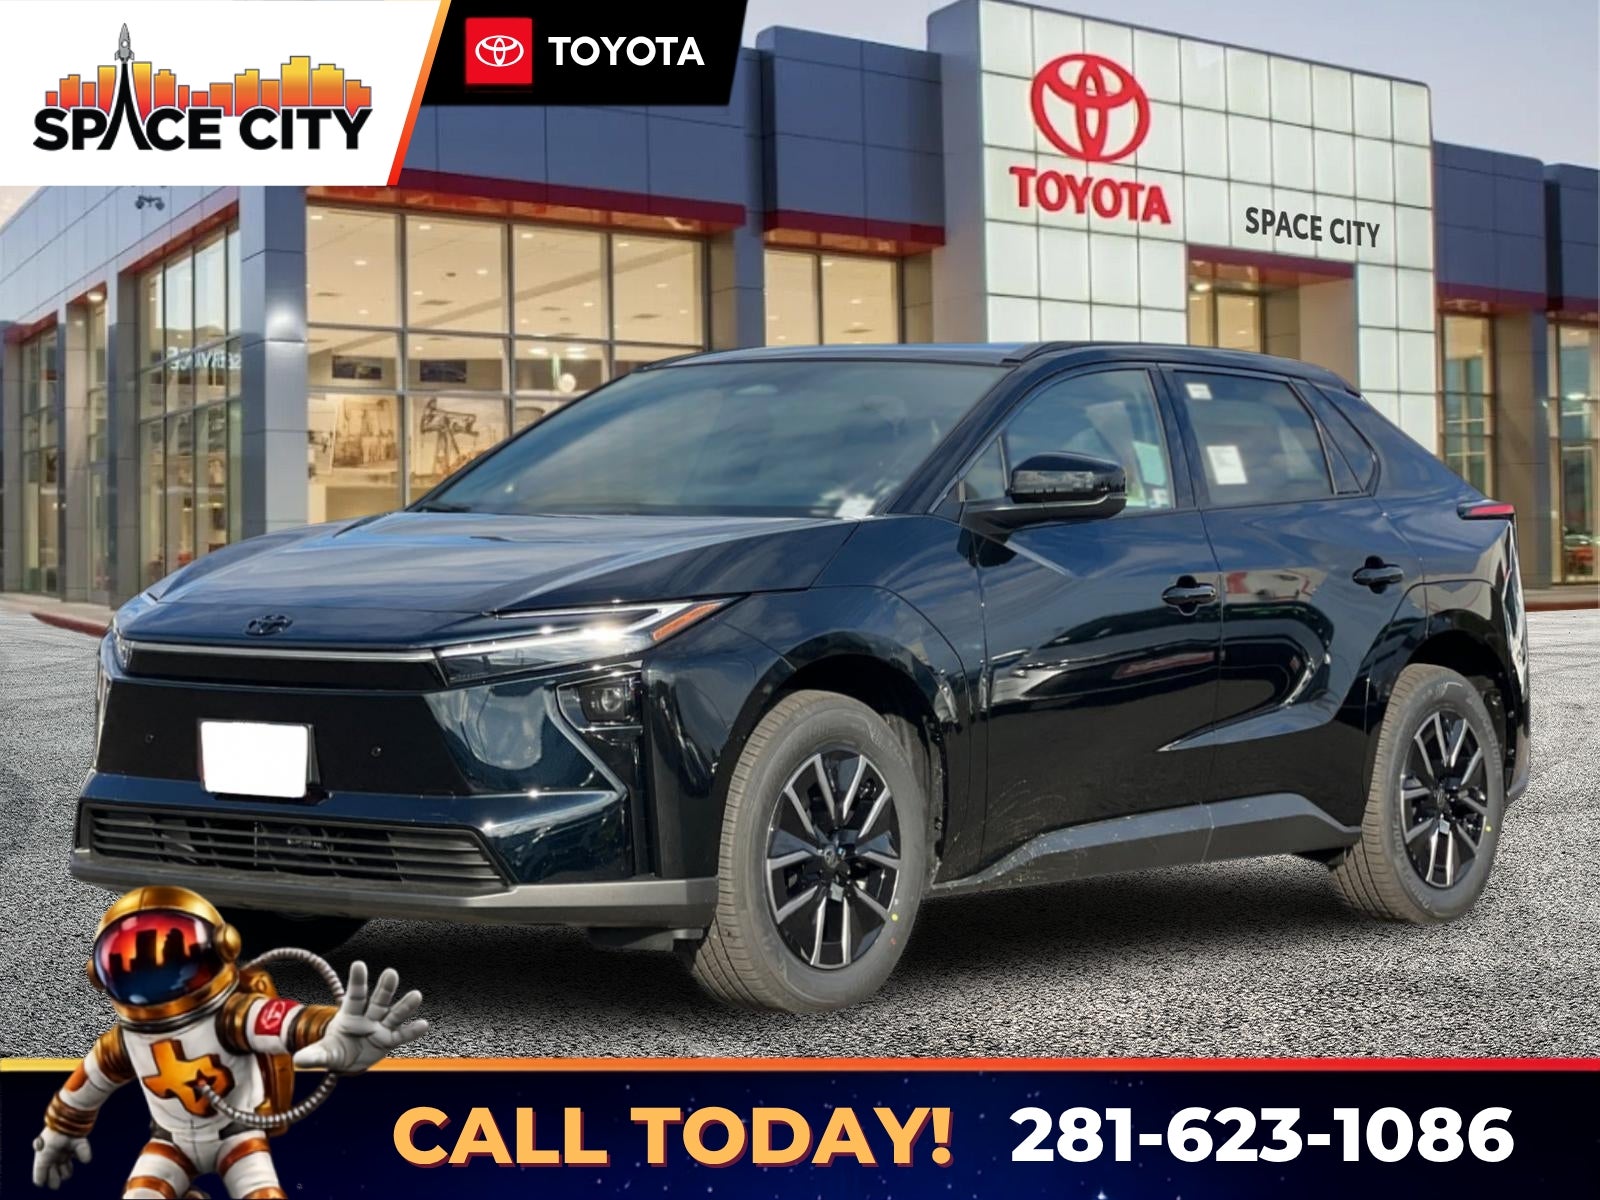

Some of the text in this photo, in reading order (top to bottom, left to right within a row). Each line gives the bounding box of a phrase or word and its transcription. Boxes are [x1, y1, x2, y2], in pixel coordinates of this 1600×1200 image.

[1009, 166, 1171, 223] TOYOTA
[1244, 206, 1381, 248] SPACE CITY
